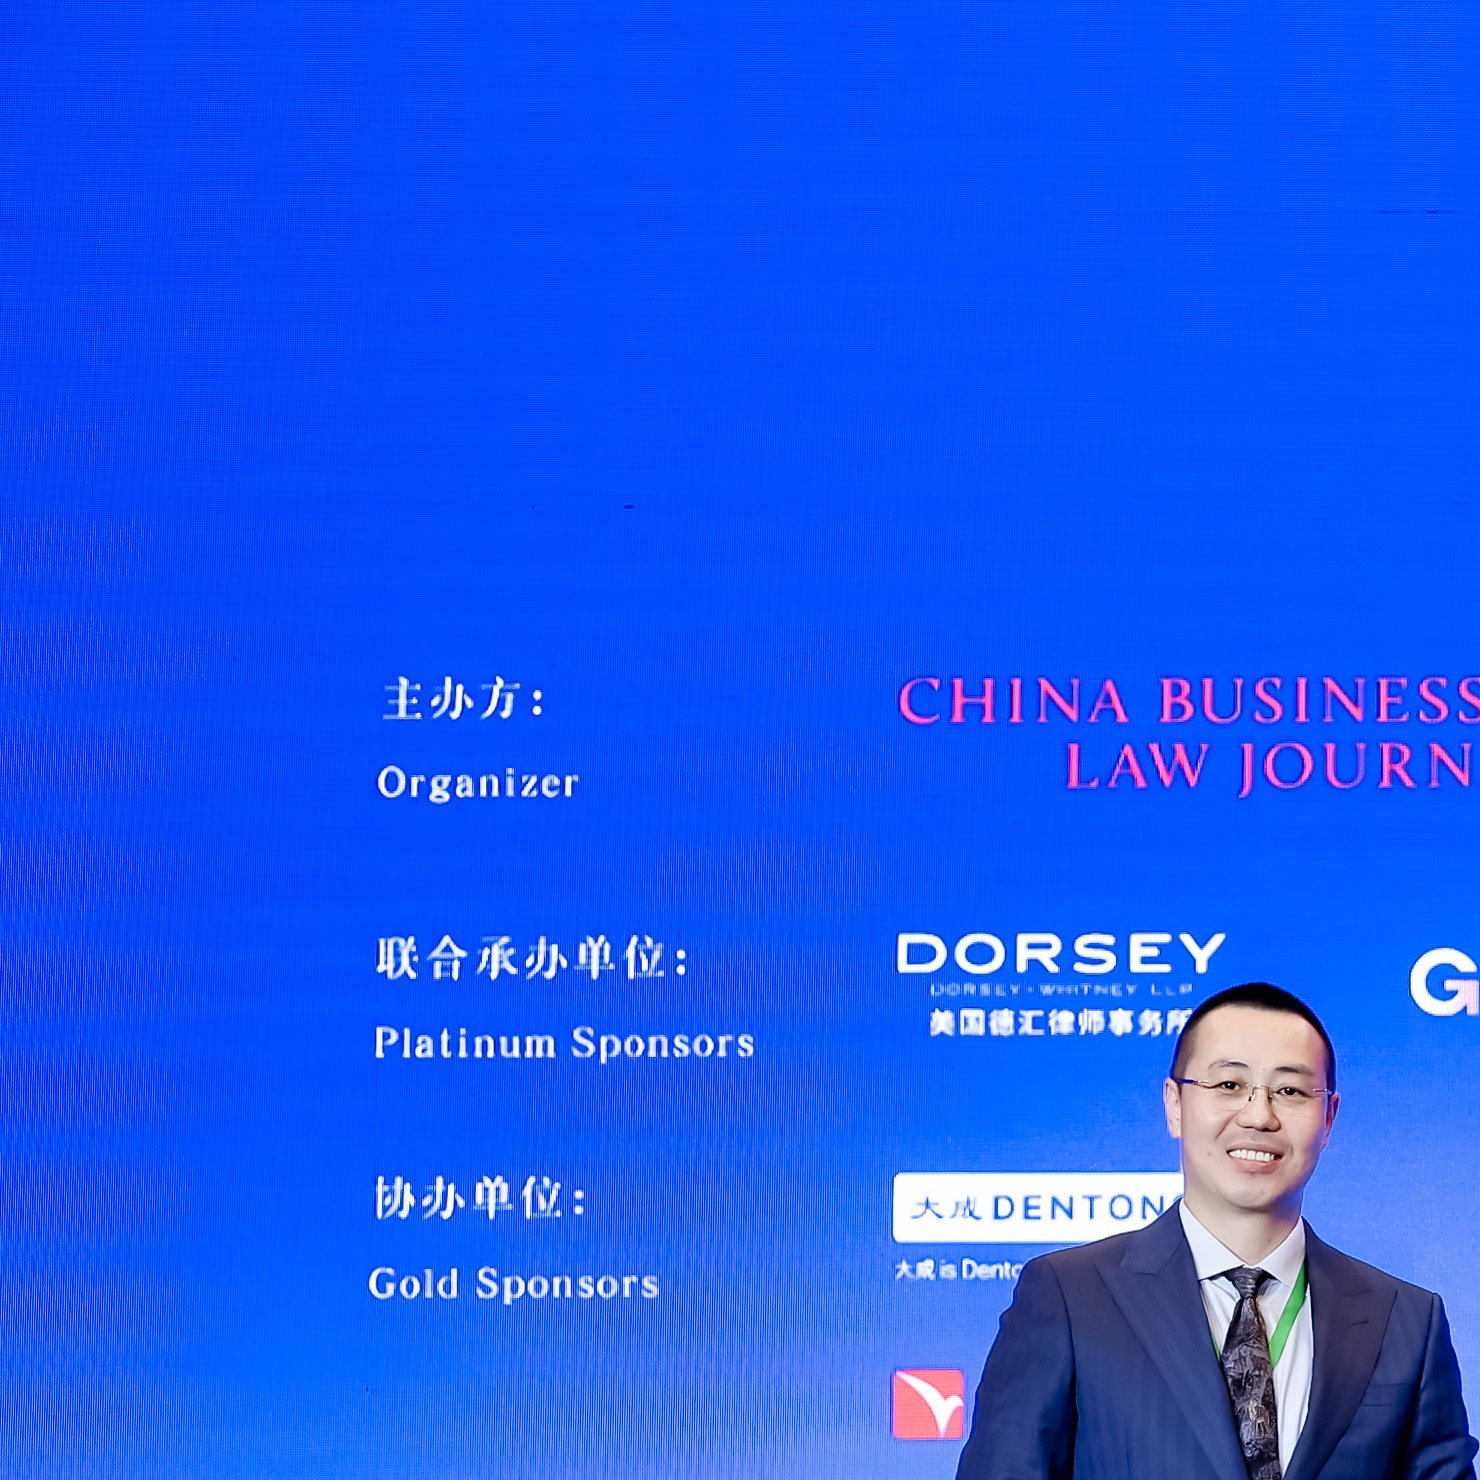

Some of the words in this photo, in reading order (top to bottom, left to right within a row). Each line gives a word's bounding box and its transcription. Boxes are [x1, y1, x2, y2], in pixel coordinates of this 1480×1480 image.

[900, 678, 1128, 724] CHINA
[378, 766, 578, 803] Organizer
[1068, 743, 1208, 788] LAW
[898, 933, 1225, 974] DORSEY
[376, 1027, 555, 1058] Platinum
[572, 1027, 754, 1064] Sponsors
[992, 1193, 1185, 1221] DENTON
[369, 1268, 457, 1299] Gold
[477, 1267, 659, 1305] Sponsors
